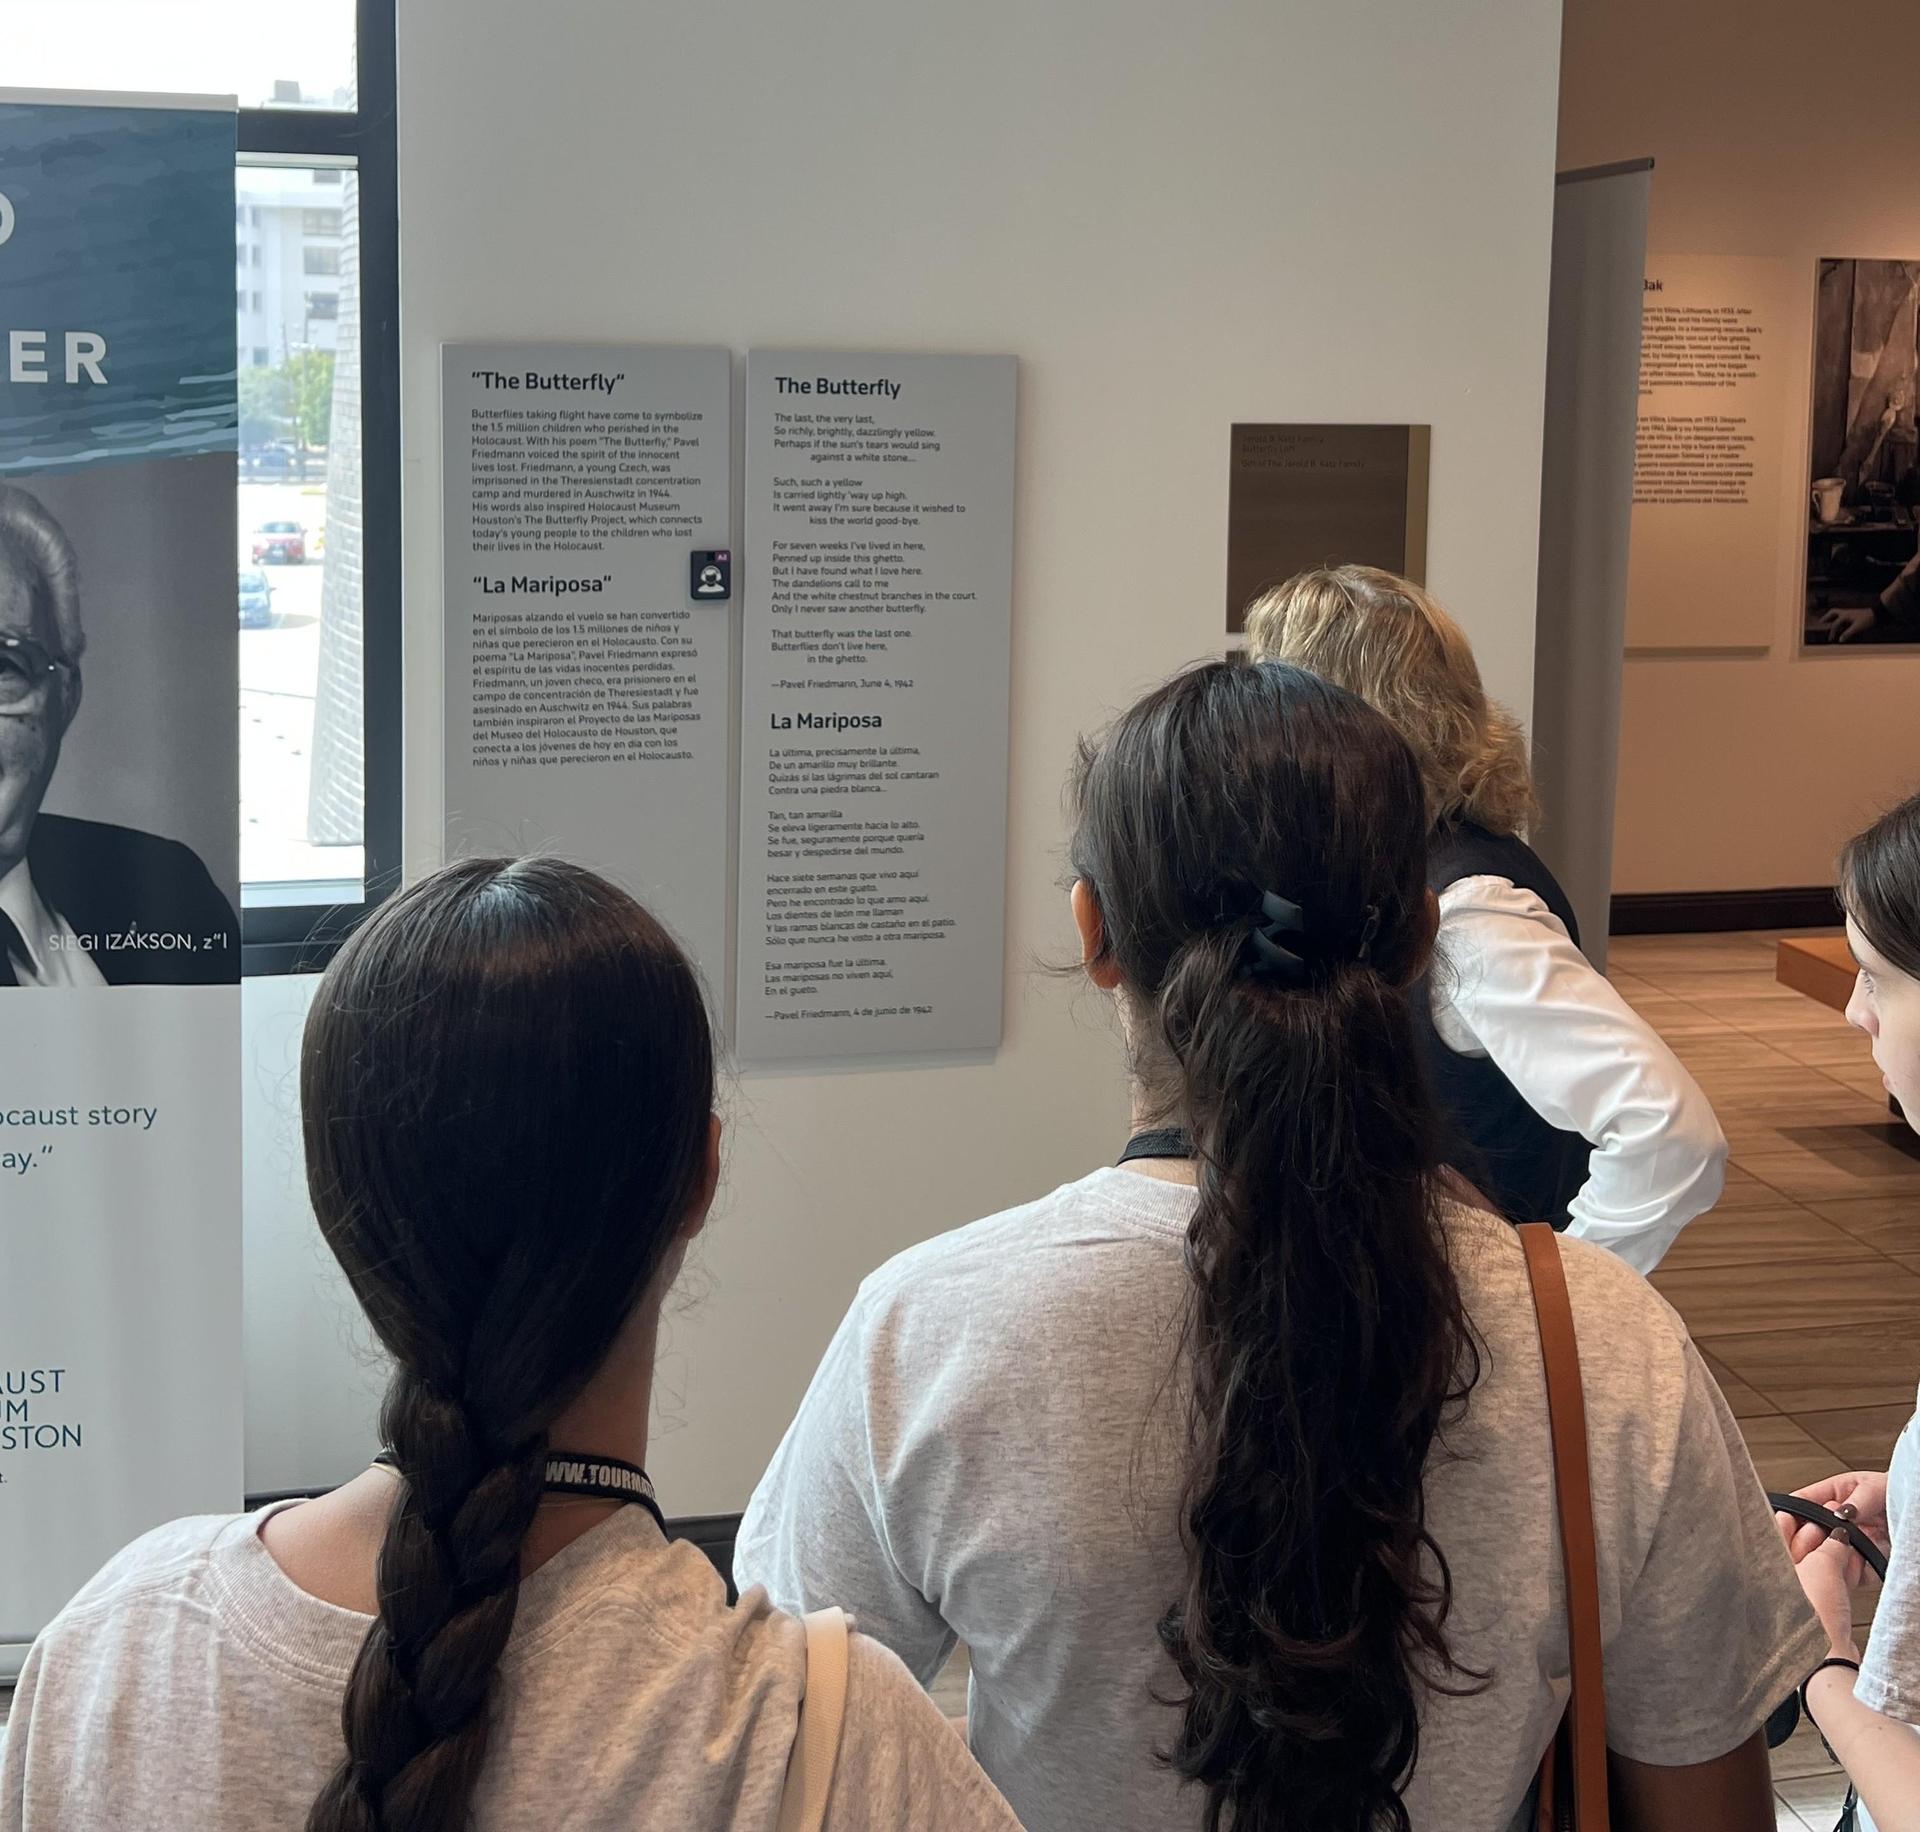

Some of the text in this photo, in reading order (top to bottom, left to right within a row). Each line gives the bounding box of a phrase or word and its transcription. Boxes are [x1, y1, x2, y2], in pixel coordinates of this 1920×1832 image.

[775, 377, 902, 399] The Butterfly
[471, 408, 703, 422] Butterflies taking flight have come to symbolize
[774, 412, 793, 422] The
[815, 415, 832, 423] the
[833, 416, 854, 424] very
[471, 422, 489, 432] the
[505, 423, 540, 433] million
[541, 423, 582, 433] children
[583, 423, 606, 433] who
[607, 423, 650, 435] perished
[651, 423, 661, 433] in
[662, 424, 679, 434] the
[525, 436, 550, 446] With
[551, 436, 567, 446] his
[568, 438, 598, 448] poem
[673, 437, 700, 447] Pavel
[471, 448, 680, 461] Friedmann voiced the spirit of the innocent
[471, 475, 701, 486] imprisoned in the Theresienstadt concentration
[472, 501, 681, 513] His words also inspired Holocaust Museum
[772, 503, 780, 511] It
[782, 503, 806, 512] went
[807, 504, 833, 513] away
[872, 503, 911, 513] because
[912, 504, 920, 513] it
[921, 504, 954, 513] wished
[956, 504, 966, 513] to
[523, 515, 543, 524] The
[545, 514, 590, 526] Butterfly
[628, 515, 658, 524] which
[659, 515, 703, 524] connects
[510, 529, 542, 540] young
[543, 528, 578, 539] people
[579, 528, 591, 538] to
[591, 528, 609, 537] the
[610, 527, 650, 537] children
[651, 527, 673, 537] who
[674, 527, 693, 537] lost
[472, 542, 496, 551] their
[497, 541, 521, 551] lives
[522, 542, 533, 551] in
[534, 542, 552, 551] the
[770, 591, 791, 601] And
[792, 592, 809, 601] the
[809, 591, 837, 601] white
[837, 592, 879, 601] chestnut
[880, 591, 923, 601] branches
[924, 591, 934, 600] in
[934, 591, 951, 600] the
[472, 611, 691, 623] Mariposas alzando el vuelo se han convertido
[771, 628, 793, 639] That
[794, 629, 835, 639] butterfly
[836, 630, 856, 638] was
[856, 629, 873, 638] the
[874, 629, 892, 638] last
[472, 665, 483, 675] el
[523, 664, 537, 674] de
[538, 665, 554, 674] las
[554, 664, 582, 673] vidas
[582, 663, 631, 673] inocentes
[859, 678, 883, 688] June
[894, 679, 914, 688] 1942
[515, 717, 566, 727] inspiraron
[566, 715, 577, 725] el
[578, 714, 622, 726] Proyecto
[621, 714, 635, 723] de
[636, 713, 652, 722] las
[652, 712, 701, 723] Mariposas
[771, 712, 882, 732] La Mariposa
[49, 934, 98, 950] SIEGI
[0, 1105, 157, 1130] caust story
[0, 1369, 66, 1395] UST
[0, 1398, 28, 1423] M
[2, 1423, 82, 1450] STON
